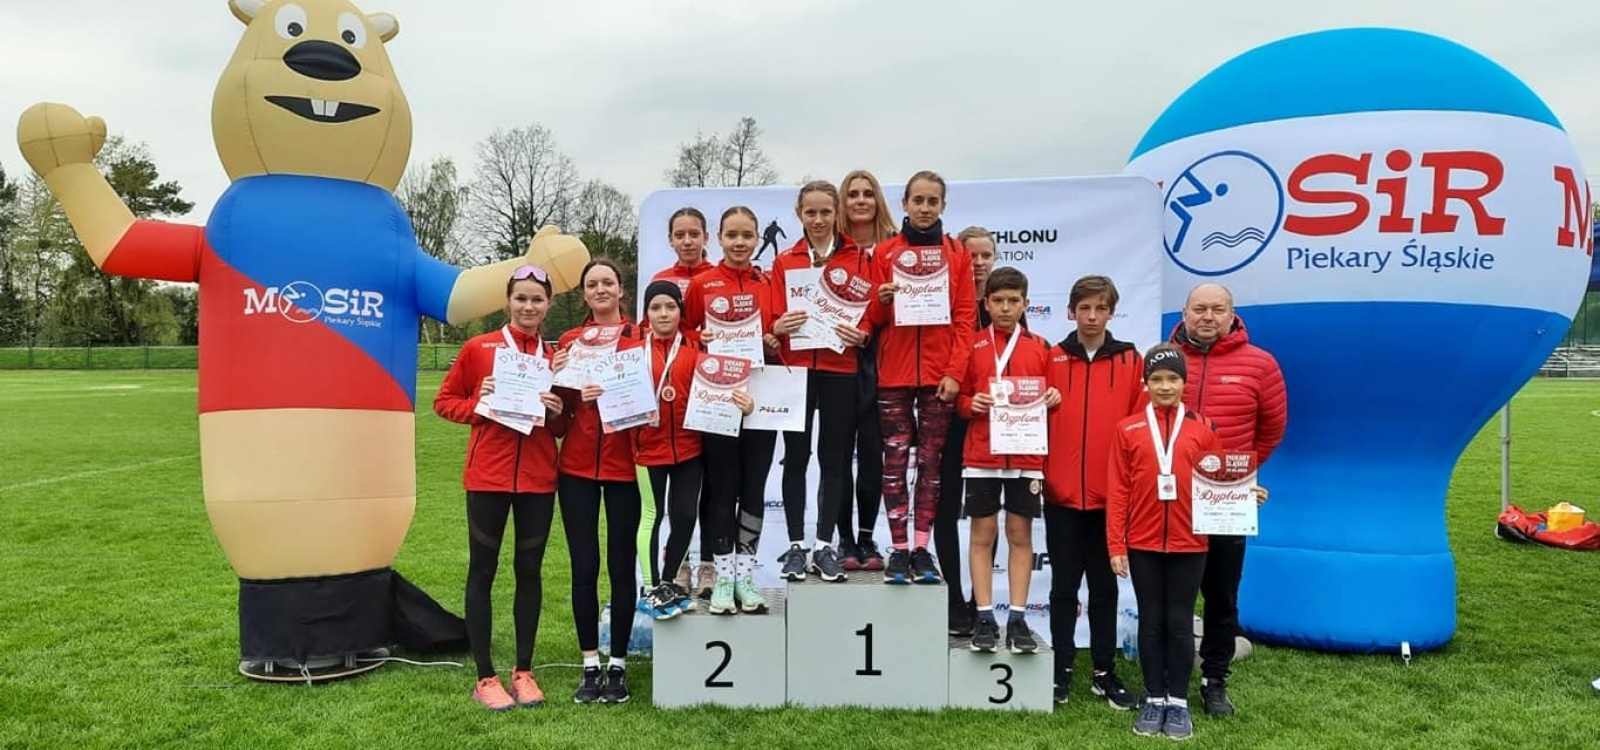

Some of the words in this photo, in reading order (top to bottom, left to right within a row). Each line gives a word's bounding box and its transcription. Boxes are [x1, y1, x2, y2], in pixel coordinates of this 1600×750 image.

[1287, 246, 1391, 273] Piekary
[1401, 239, 1495, 271] Śląskie
[325, 316, 354, 326] Piekary
[499, 353, 544, 371] DYPLOM
[594, 352, 640, 373] DYPLOM
[996, 412, 1041, 427] Dyplom
[1199, 490, 1249, 505] Dyplom
[856, 623, 882, 676] 1
[705, 641, 734, 687] 2
[988, 663, 1014, 703] 3
